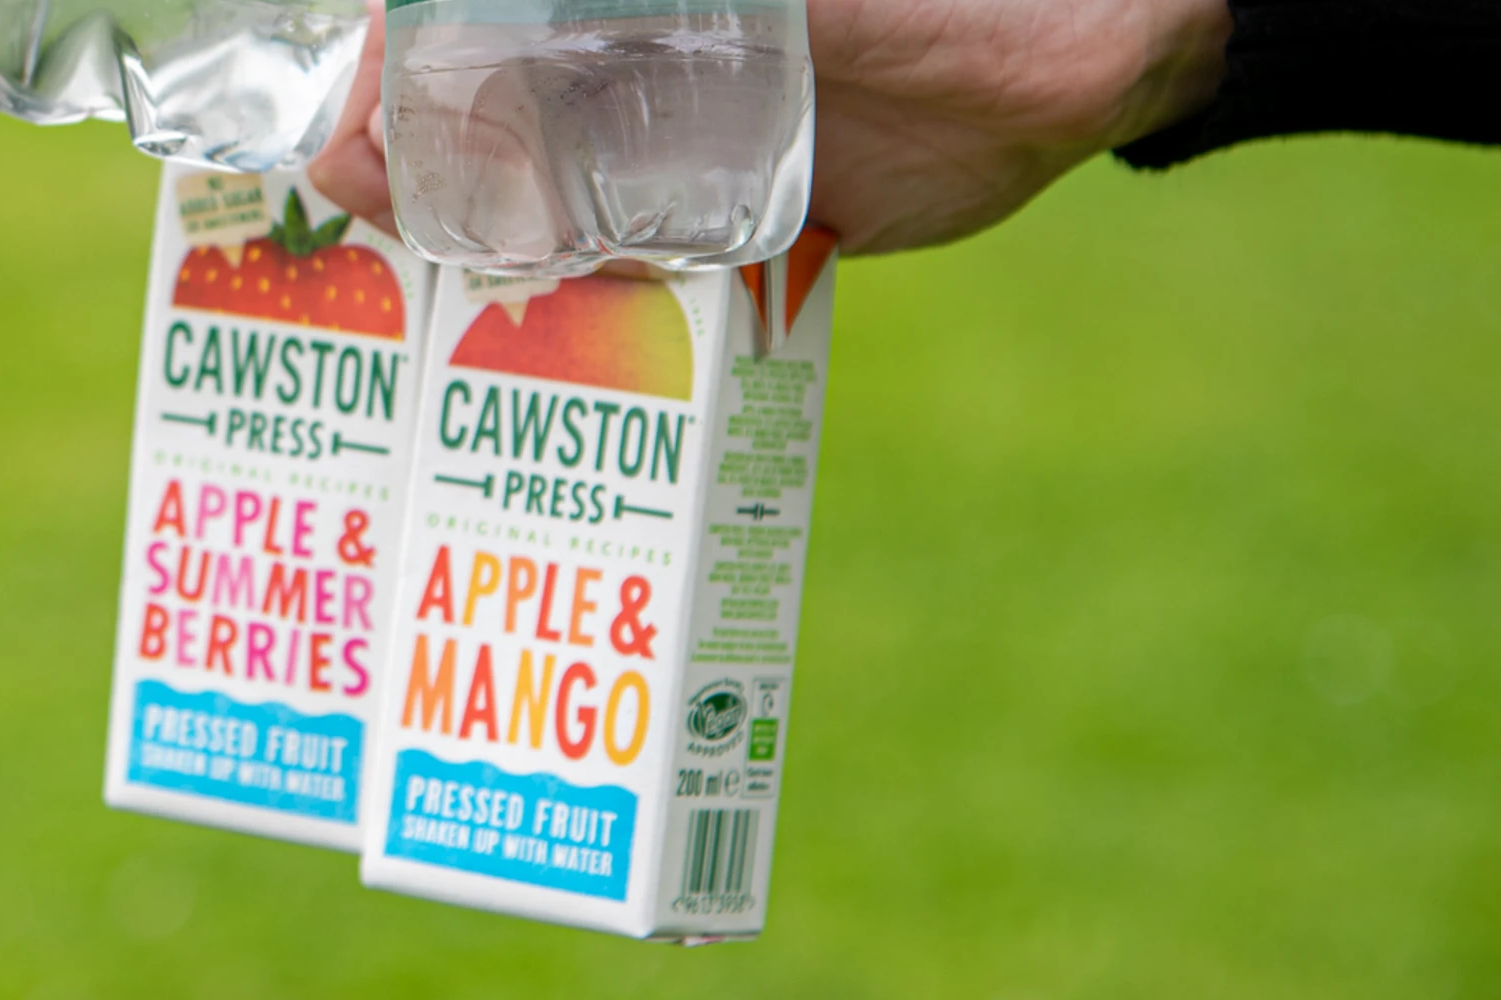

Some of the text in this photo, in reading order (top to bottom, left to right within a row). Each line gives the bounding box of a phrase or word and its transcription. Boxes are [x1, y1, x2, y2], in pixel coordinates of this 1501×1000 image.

[163, 320, 399, 422] CAWSTON
[225, 408, 323, 460] PRESS
[439, 379, 686, 485] CAWSTON
[153, 479, 376, 568] APPLE &
[502, 470, 606, 525] PRESS
[425, 512, 551, 548] ORIGINAL
[569, 535, 673, 568] RECIPES
[145, 540, 375, 631] SUMMER
[415, 543, 604, 649] APPLE
[609, 574, 659, 661] &
[138, 602, 370, 698] BERRIES
[399, 632, 652, 767] MANGO
[697, 701, 741, 737] Vegan
[143, 703, 348, 774] PRESSED FRUIT
[406, 774, 618, 849] PRESSED FRUIT
[676, 768, 703, 796] 200
[705, 768, 722, 796] ml
[402, 813, 615, 878] SHAKEN UP WITH WATER
